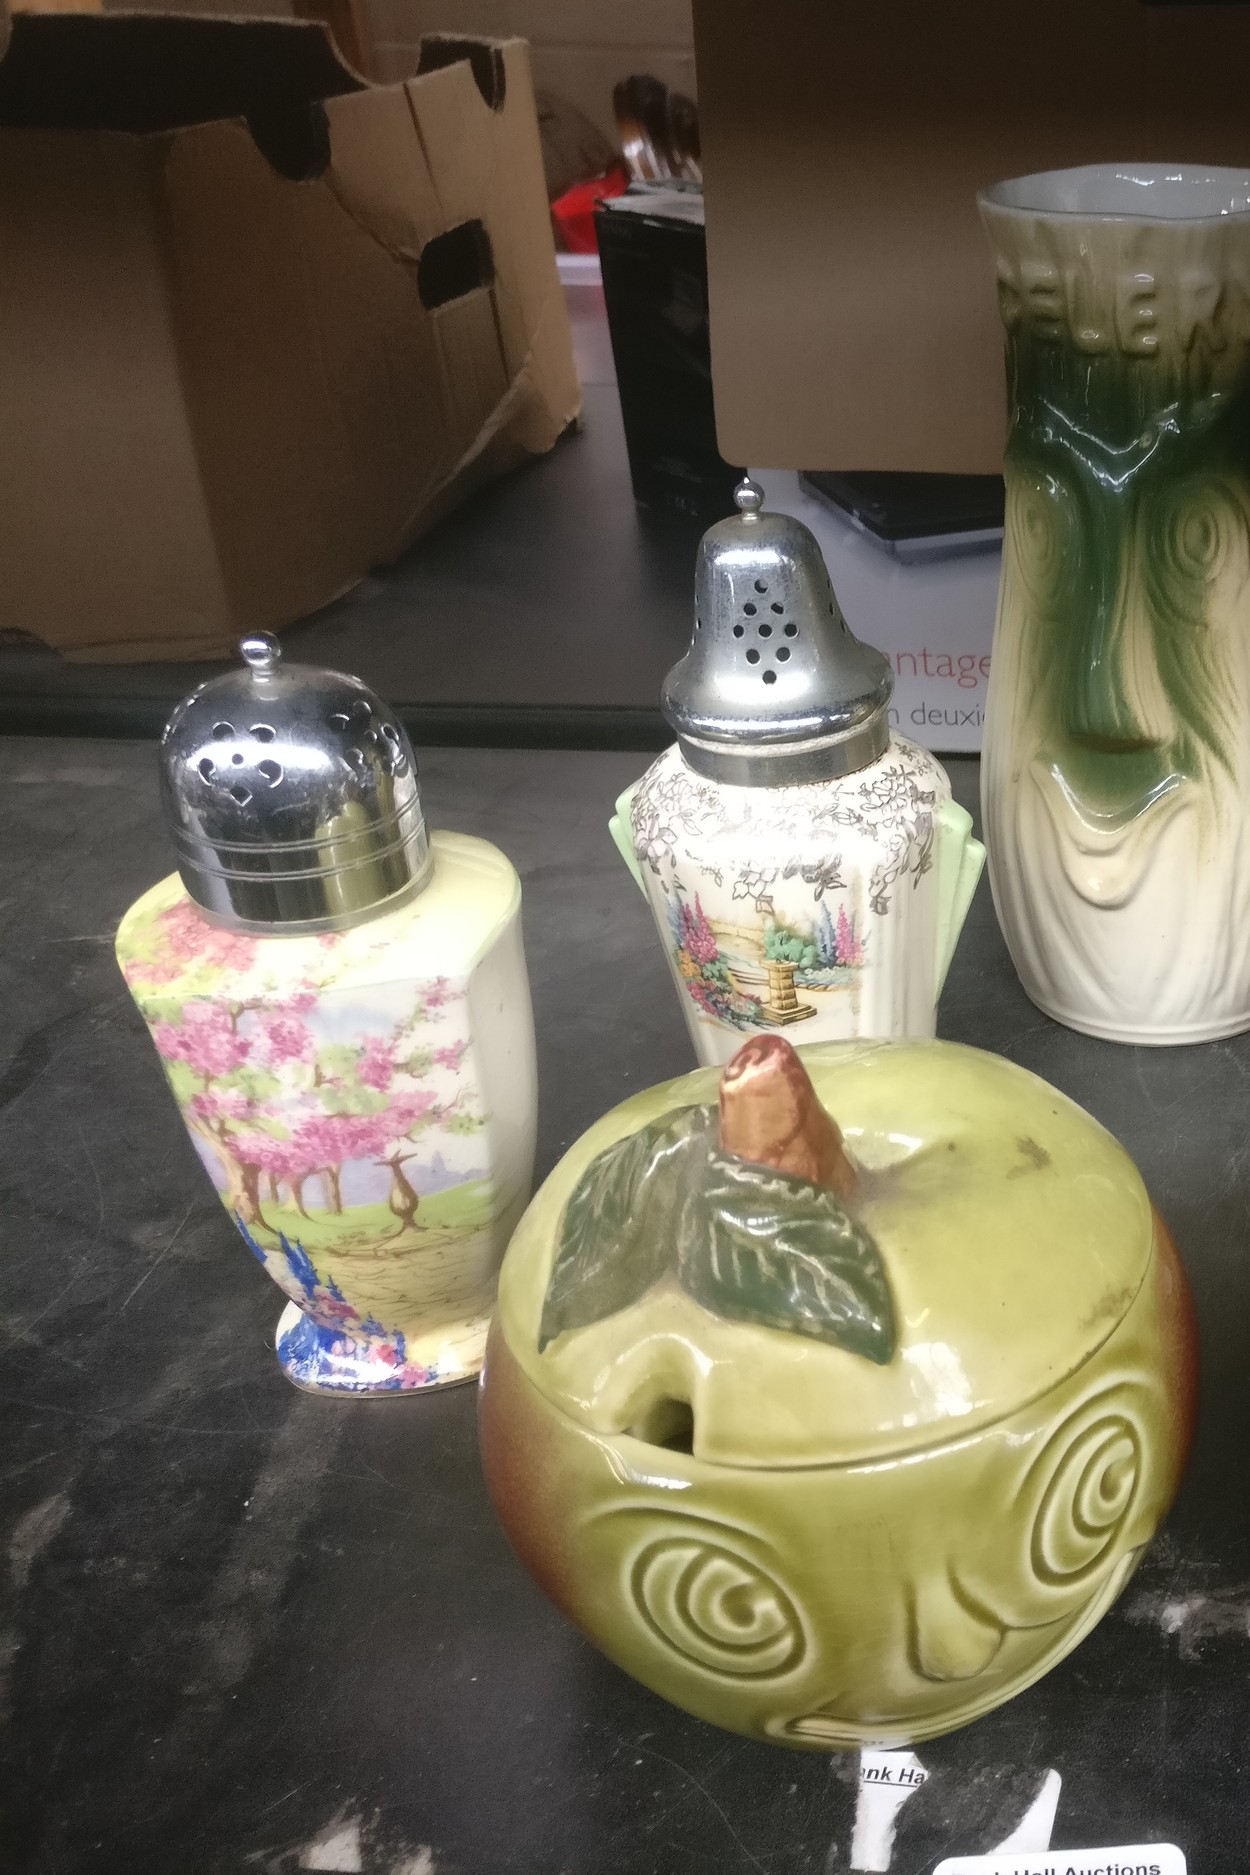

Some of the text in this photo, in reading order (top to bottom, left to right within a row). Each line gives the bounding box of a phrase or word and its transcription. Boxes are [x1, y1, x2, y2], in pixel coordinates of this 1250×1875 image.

[884, 647, 991, 689] ntage
[910, 702, 985, 727] deuxi
[862, 1766, 893, 1782] nk
